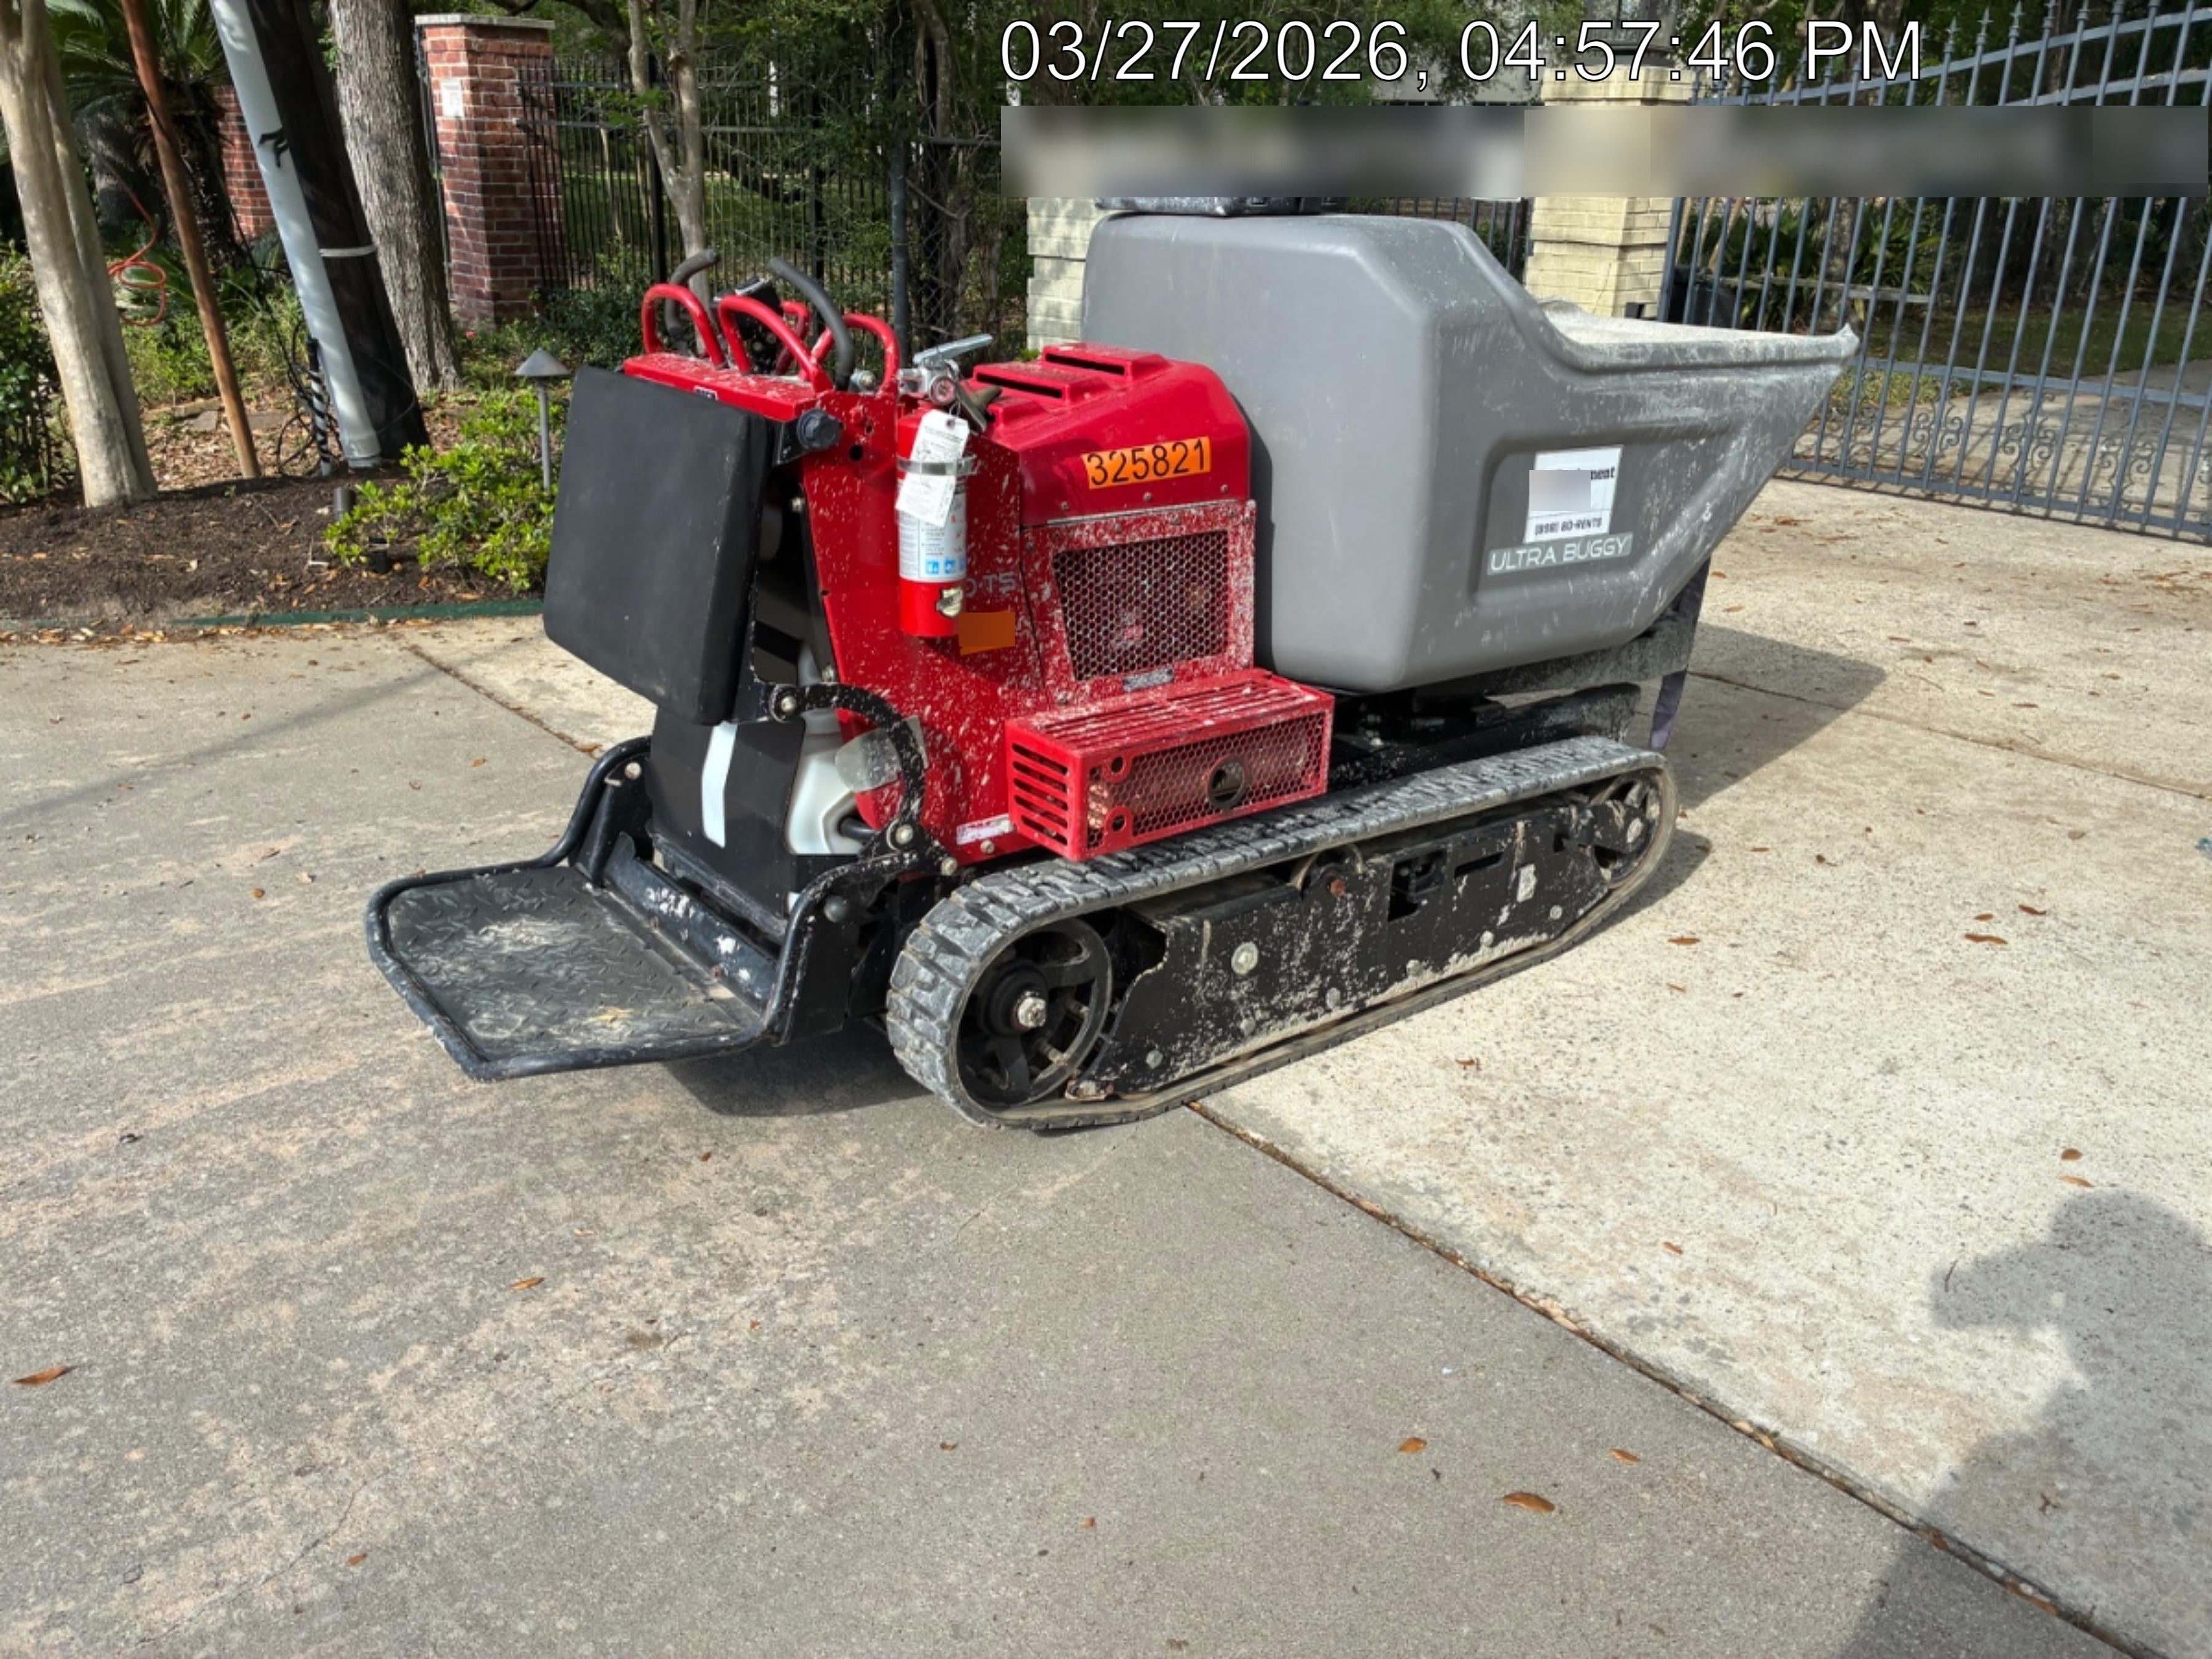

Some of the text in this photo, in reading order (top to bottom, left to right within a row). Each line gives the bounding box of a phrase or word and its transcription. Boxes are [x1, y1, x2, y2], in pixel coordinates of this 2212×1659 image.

[1087, 438, 1204, 485] 325821
[1491, 536, 1628, 570] ULTRA BUGGY
